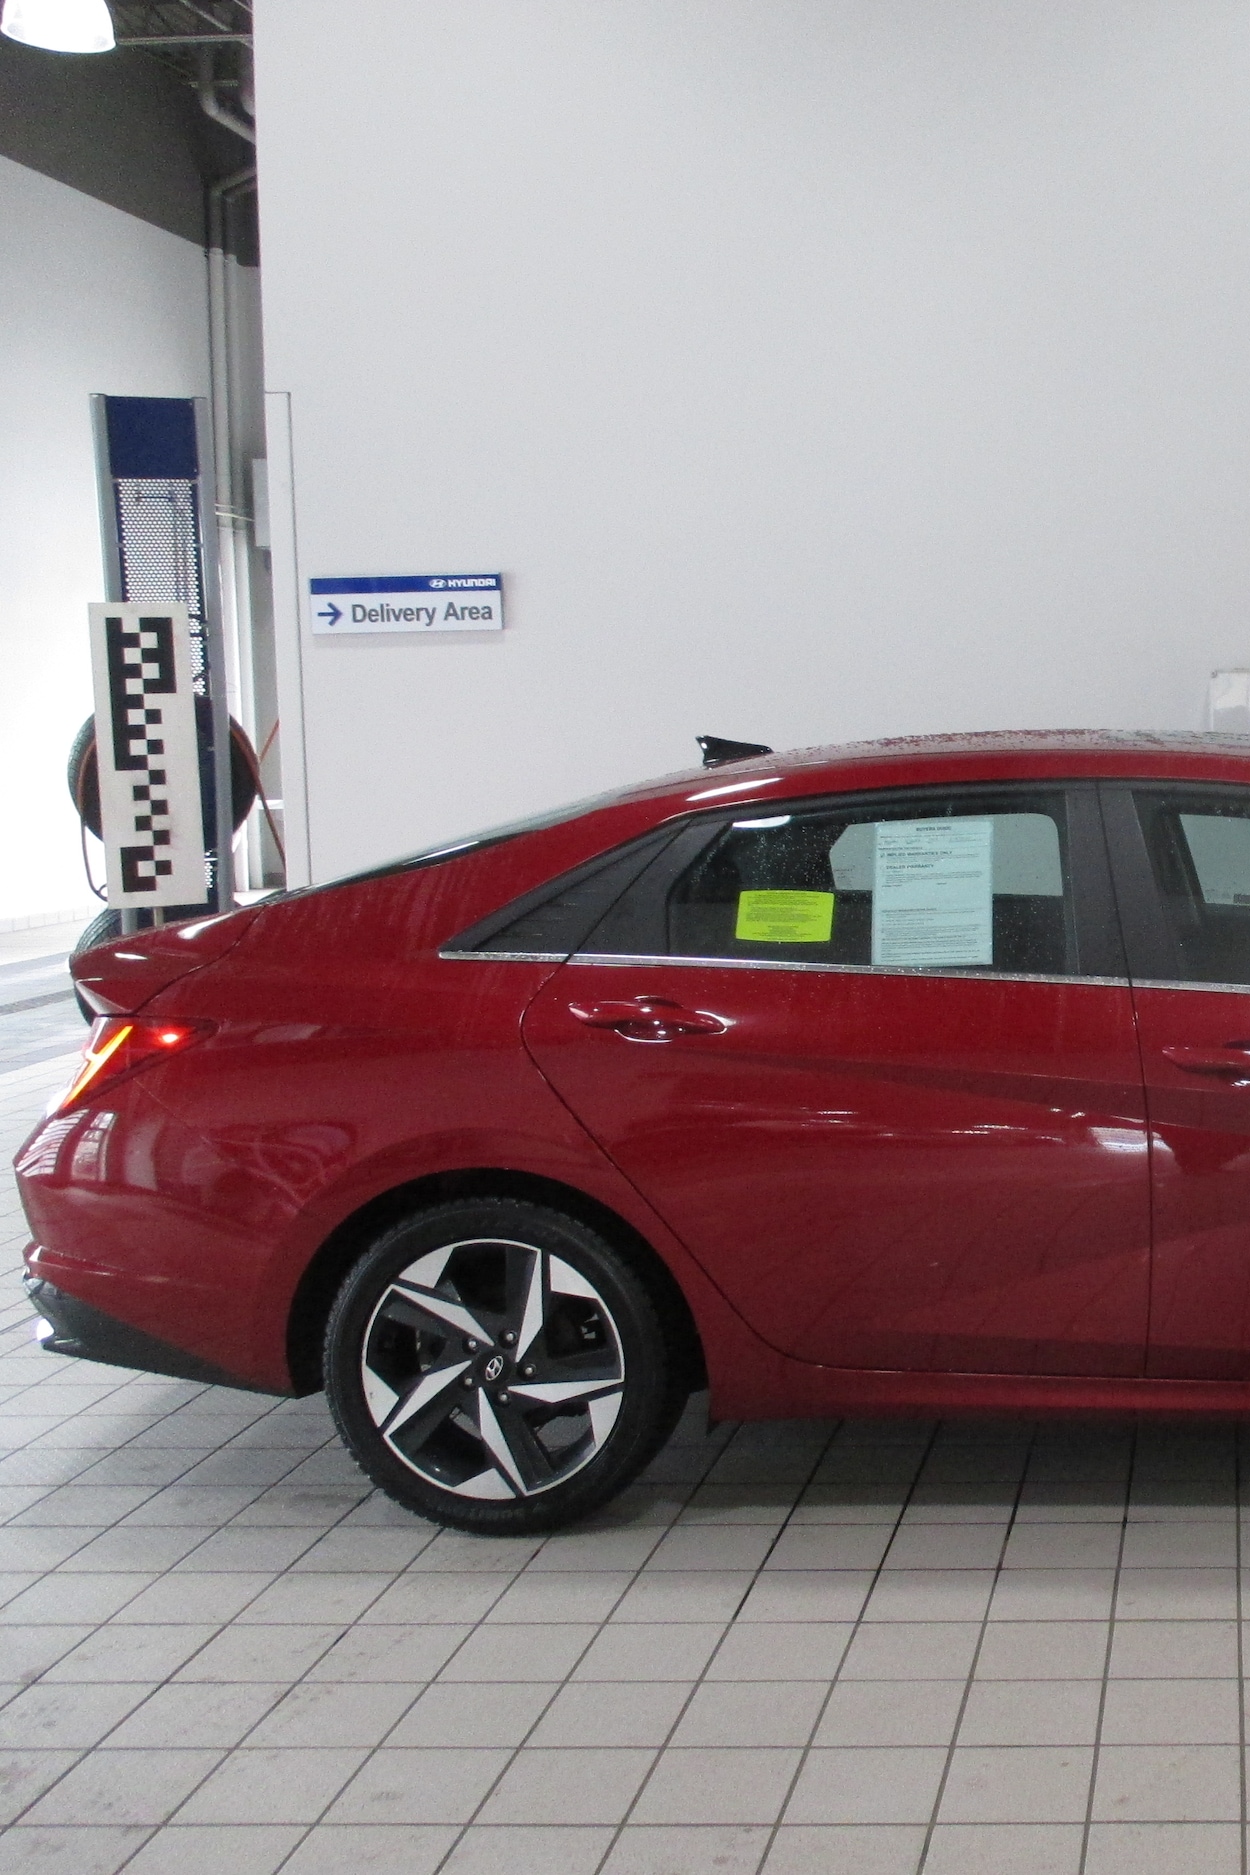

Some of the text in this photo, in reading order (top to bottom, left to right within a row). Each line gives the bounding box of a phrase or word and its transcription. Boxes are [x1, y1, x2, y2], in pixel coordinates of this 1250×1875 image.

[448, 578, 496, 587] HYUNDAI
[352, 602, 492, 626] Delivery Area
